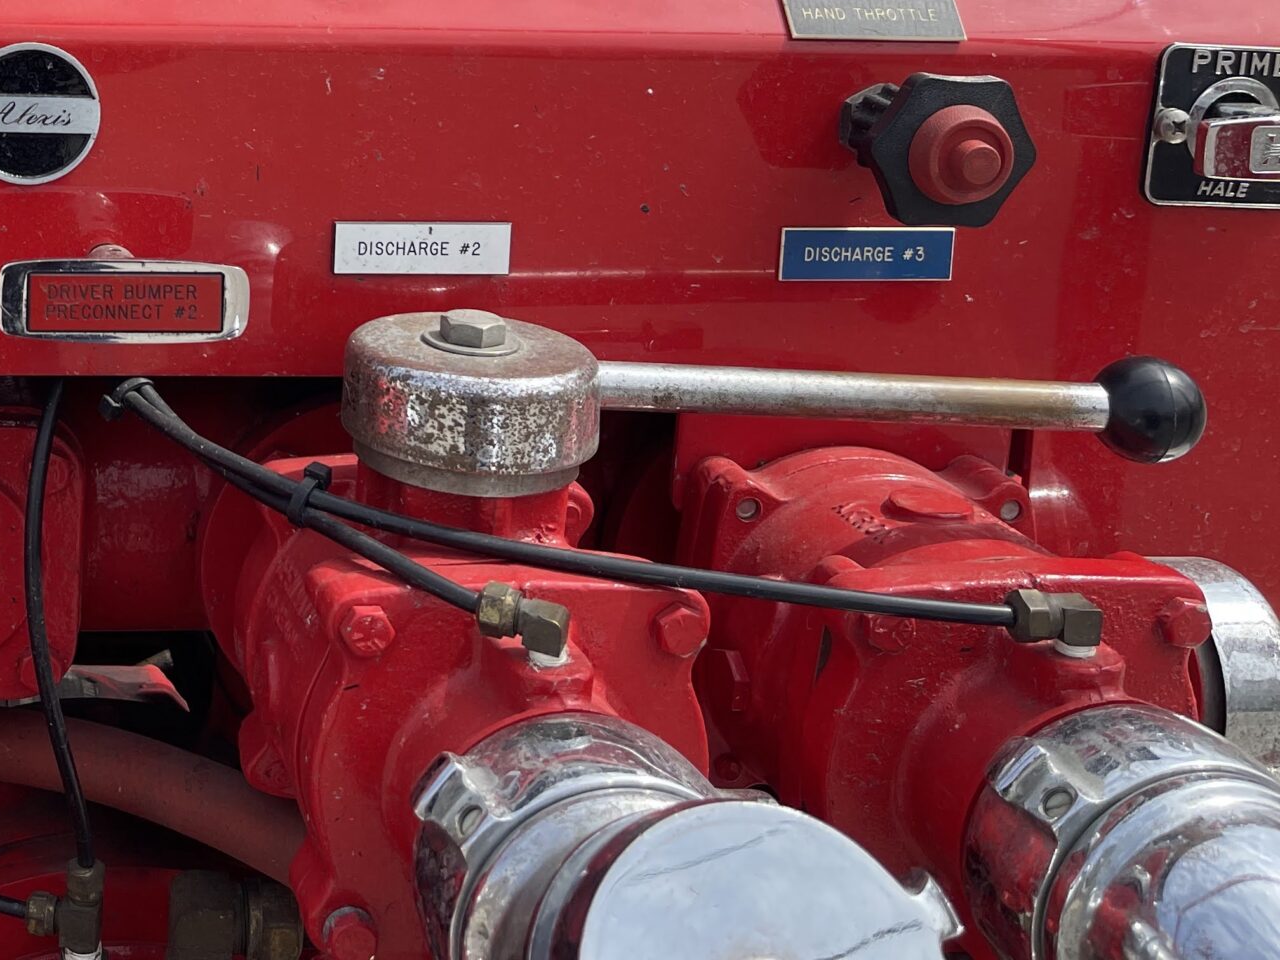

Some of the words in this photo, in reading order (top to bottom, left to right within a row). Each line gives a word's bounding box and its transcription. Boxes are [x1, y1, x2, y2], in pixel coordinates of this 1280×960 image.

[801, 7, 846, 21] HAND
[852, 7, 939, 21] THROTTLE
[1197, 181, 1250, 197] HALE
[358, 241, 450, 256] DISCHARGE
[459, 242, 481, 256] #2
[803, 246, 894, 262] DISCHARGE
[902, 247, 925, 262] #3
[47, 284, 113, 299] DRIVER
[124, 284, 198, 300] BUMPER
[46, 304, 164, 320] PRECONNECT
[174, 305, 198, 319] #2
